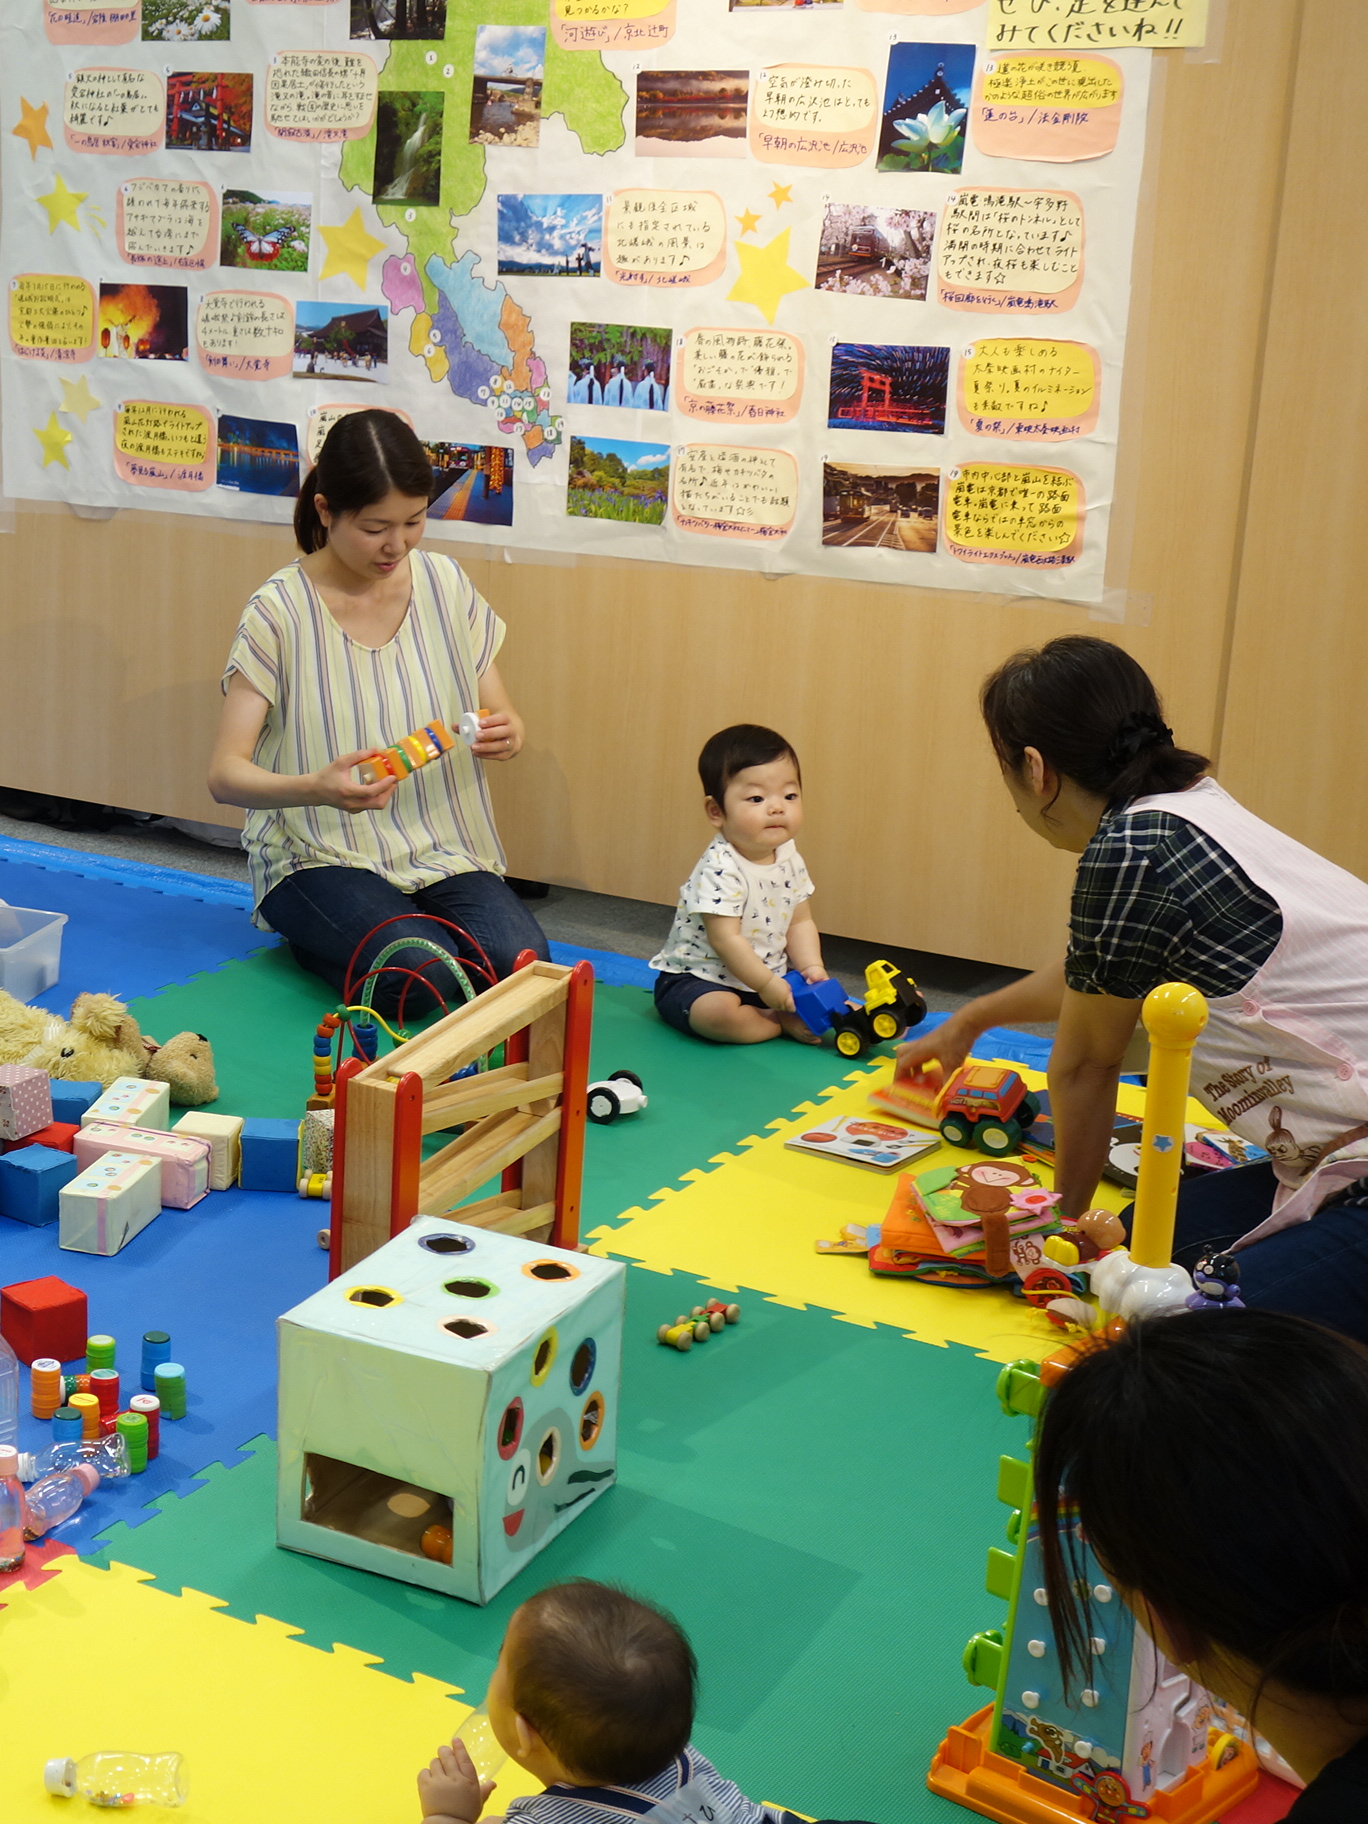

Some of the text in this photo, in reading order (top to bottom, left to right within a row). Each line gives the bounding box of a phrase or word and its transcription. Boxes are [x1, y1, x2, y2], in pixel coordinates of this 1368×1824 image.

[564, 4, 629, 16] 見つかるかな?
[996, 17, 1184, 43] みてくださいね!!
[617, 220, 711, 232] にも指定されている
[206, 296, 265, 310] 大覚寺で行われる
[979, 344, 1058, 357] 大人も楽しめる
[972, 362, 1080, 376] 太秦映画村のナイター
[962, 469, 1074, 486] 市内中心部と嵐山を結ぶ
[955, 482, 1070, 502] 嵐電は京都で唯一の路面
[952, 510, 1064, 529] 電車ならではの車窓からの
[1204, 1056, 1273, 1102] The Story of
[1217, 1074, 1295, 1126] Moominvalley
